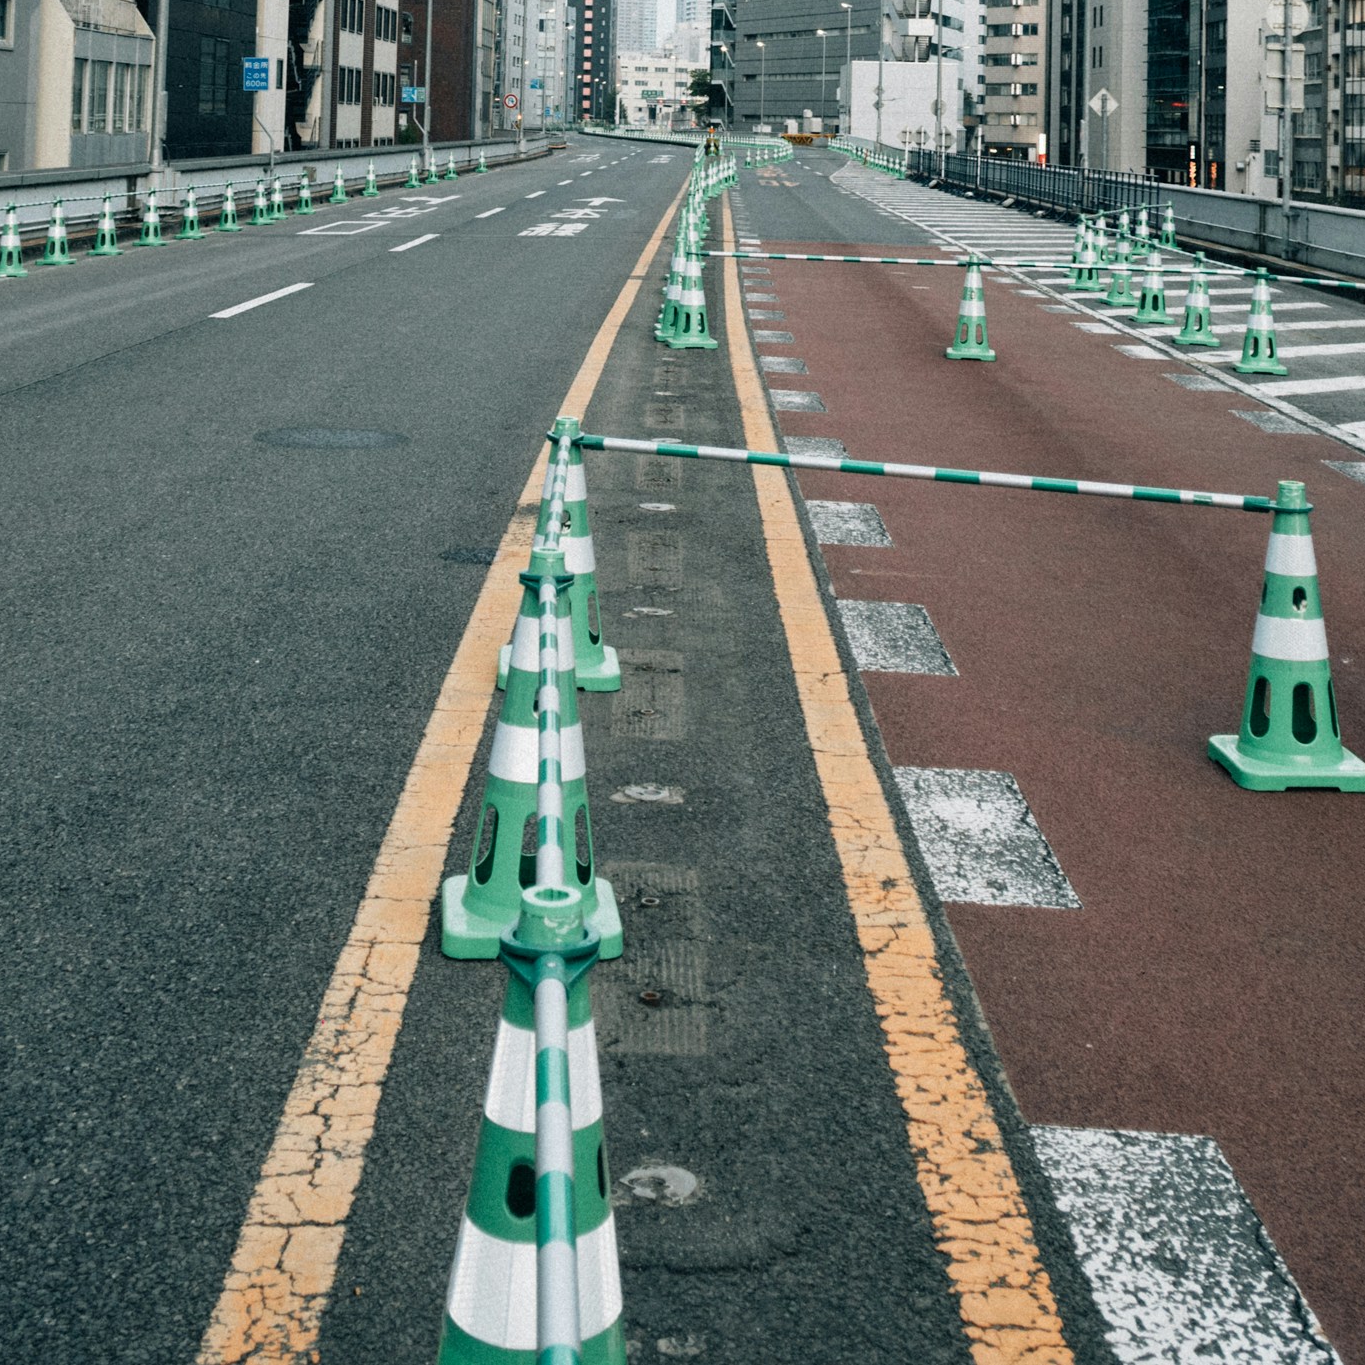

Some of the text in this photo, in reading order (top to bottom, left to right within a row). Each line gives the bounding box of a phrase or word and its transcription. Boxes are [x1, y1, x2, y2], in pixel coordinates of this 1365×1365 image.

[246, 72, 267, 80] この先
[245, 80, 267, 88] 600m
